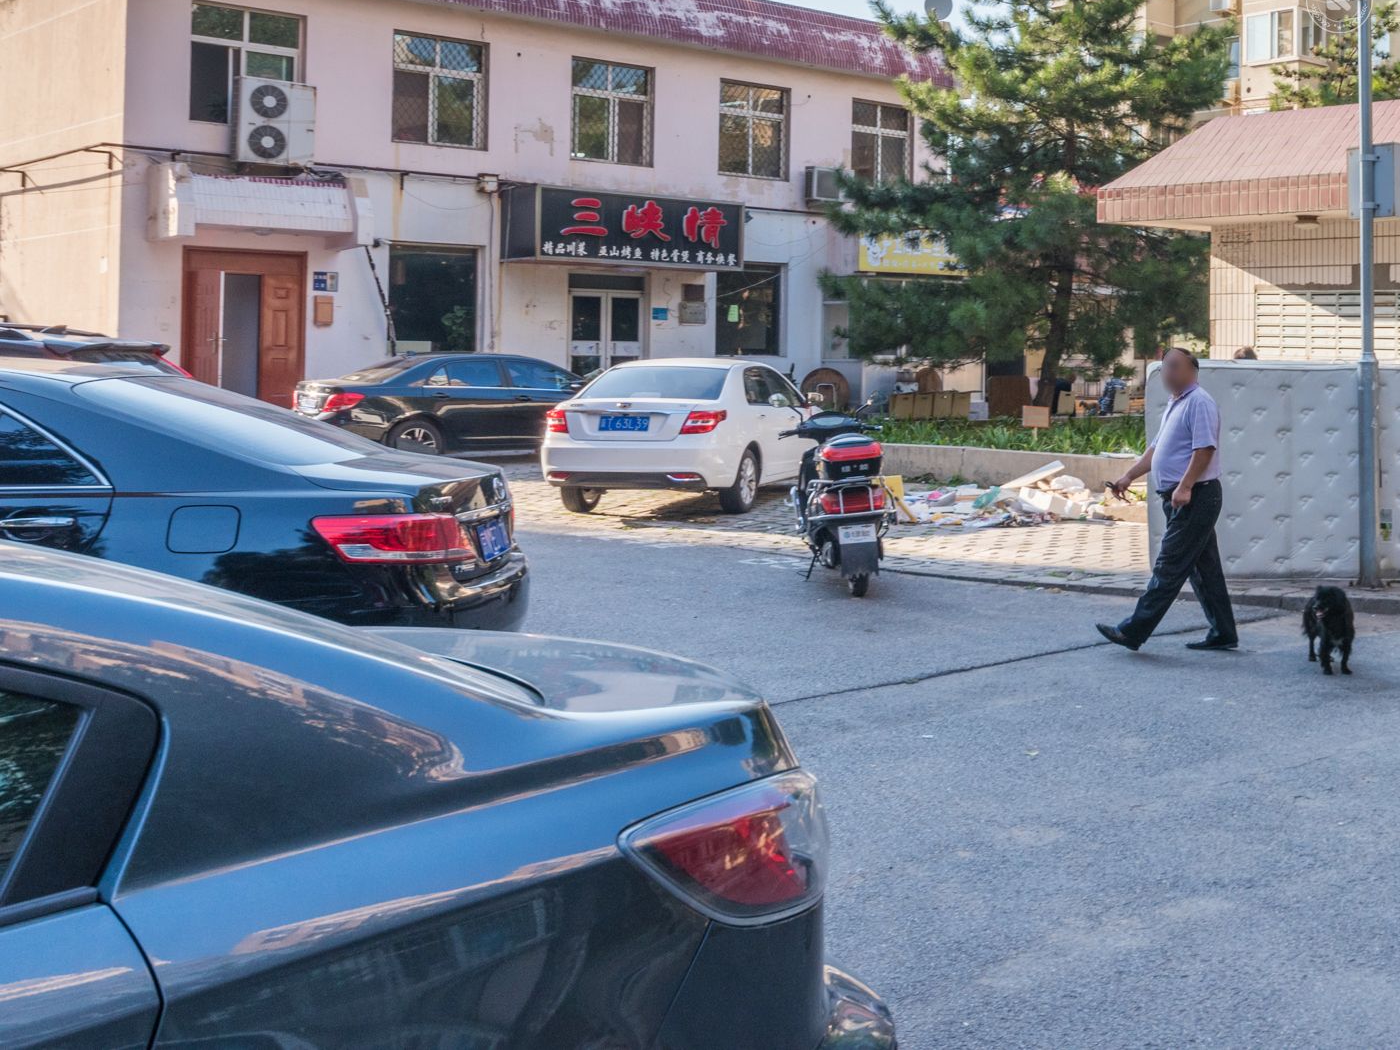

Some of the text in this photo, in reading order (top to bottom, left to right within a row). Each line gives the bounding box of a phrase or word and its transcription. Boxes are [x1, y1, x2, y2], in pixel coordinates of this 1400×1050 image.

[560, 197, 728, 249] 三峡情
[542, 240, 588, 256] 精品川菜
[696, 250, 737, 266] 商务快餐
